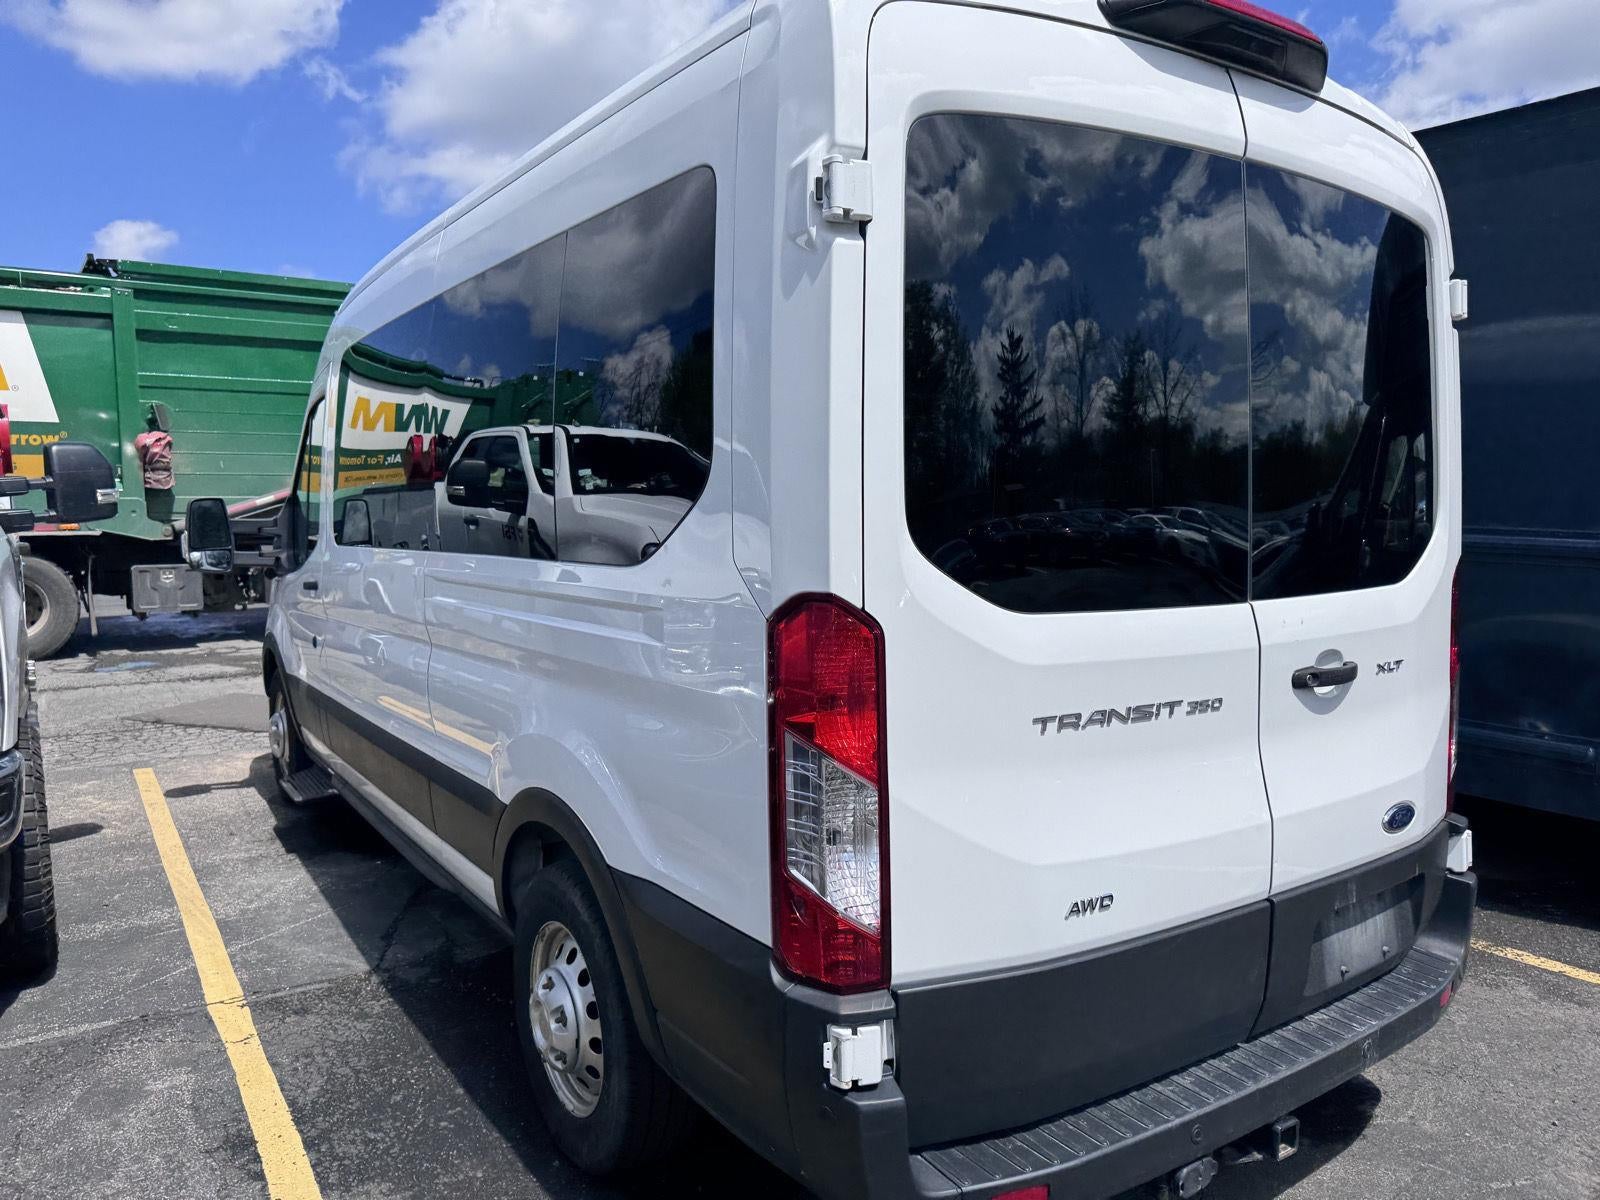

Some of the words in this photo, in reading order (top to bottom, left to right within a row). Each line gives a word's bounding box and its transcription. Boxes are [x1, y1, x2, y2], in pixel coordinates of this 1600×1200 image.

[10, 433, 60, 446] rrow
[1375, 659, 1404, 676] XLT
[1032, 699, 1184, 736] TRANSIT
[1185, 697, 1223, 717] 350
[1064, 893, 1114, 921] AWD
